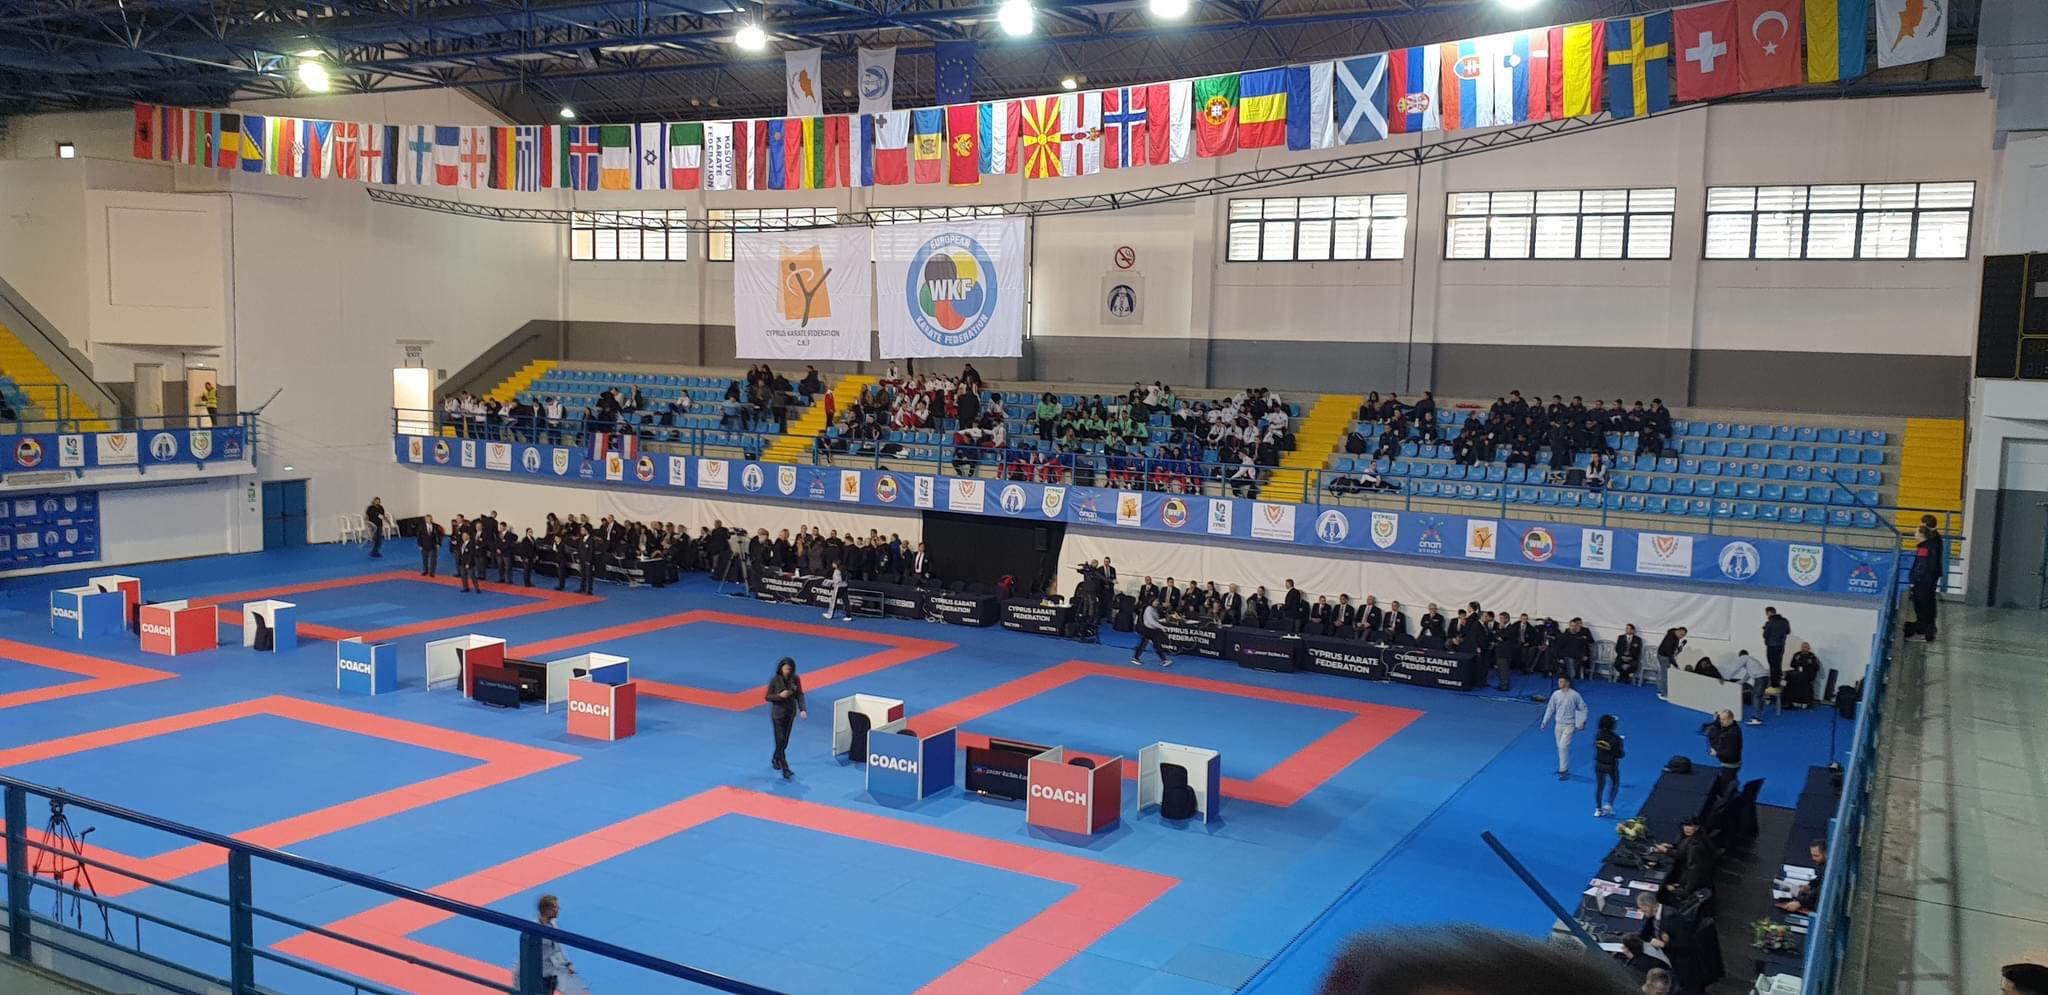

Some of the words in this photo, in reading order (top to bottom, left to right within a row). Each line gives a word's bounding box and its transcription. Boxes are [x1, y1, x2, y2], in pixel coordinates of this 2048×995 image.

[930, 235, 971, 249] EUROPEAN
[929, 279, 972, 301] WKF
[916, 315, 942, 342] KARATE
[944, 314, 989, 344] FEDERATION
[811, 586, 833, 596] CYPRU
[52, 606, 79, 621] COACH
[1008, 605, 1032, 614] CYPRUS
[1032, 607, 1057, 616] KARATE
[1013, 612, 1051, 622] FEDERATION
[141, 622, 172, 637] COACH
[1162, 626, 1189, 635] CYPRUS
[1190, 629, 1216, 639] KARATE
[1168, 634, 1210, 645] FEDERATION
[1308, 648, 1343, 661] CYPRUS
[1343, 655, 1379, 666] KARATE
[1394, 653, 1426, 664] CYPRUS
[1426, 657, 1458, 668] KARATE
[340, 659, 371, 674] COACH
[1315, 658, 1370, 674] FEDERATION
[1401, 662, 1450, 674] FEDERATION
[569, 699, 610, 717] COACH
[870, 753, 918, 774] COACH
[1030, 784, 1087, 806] COACH
